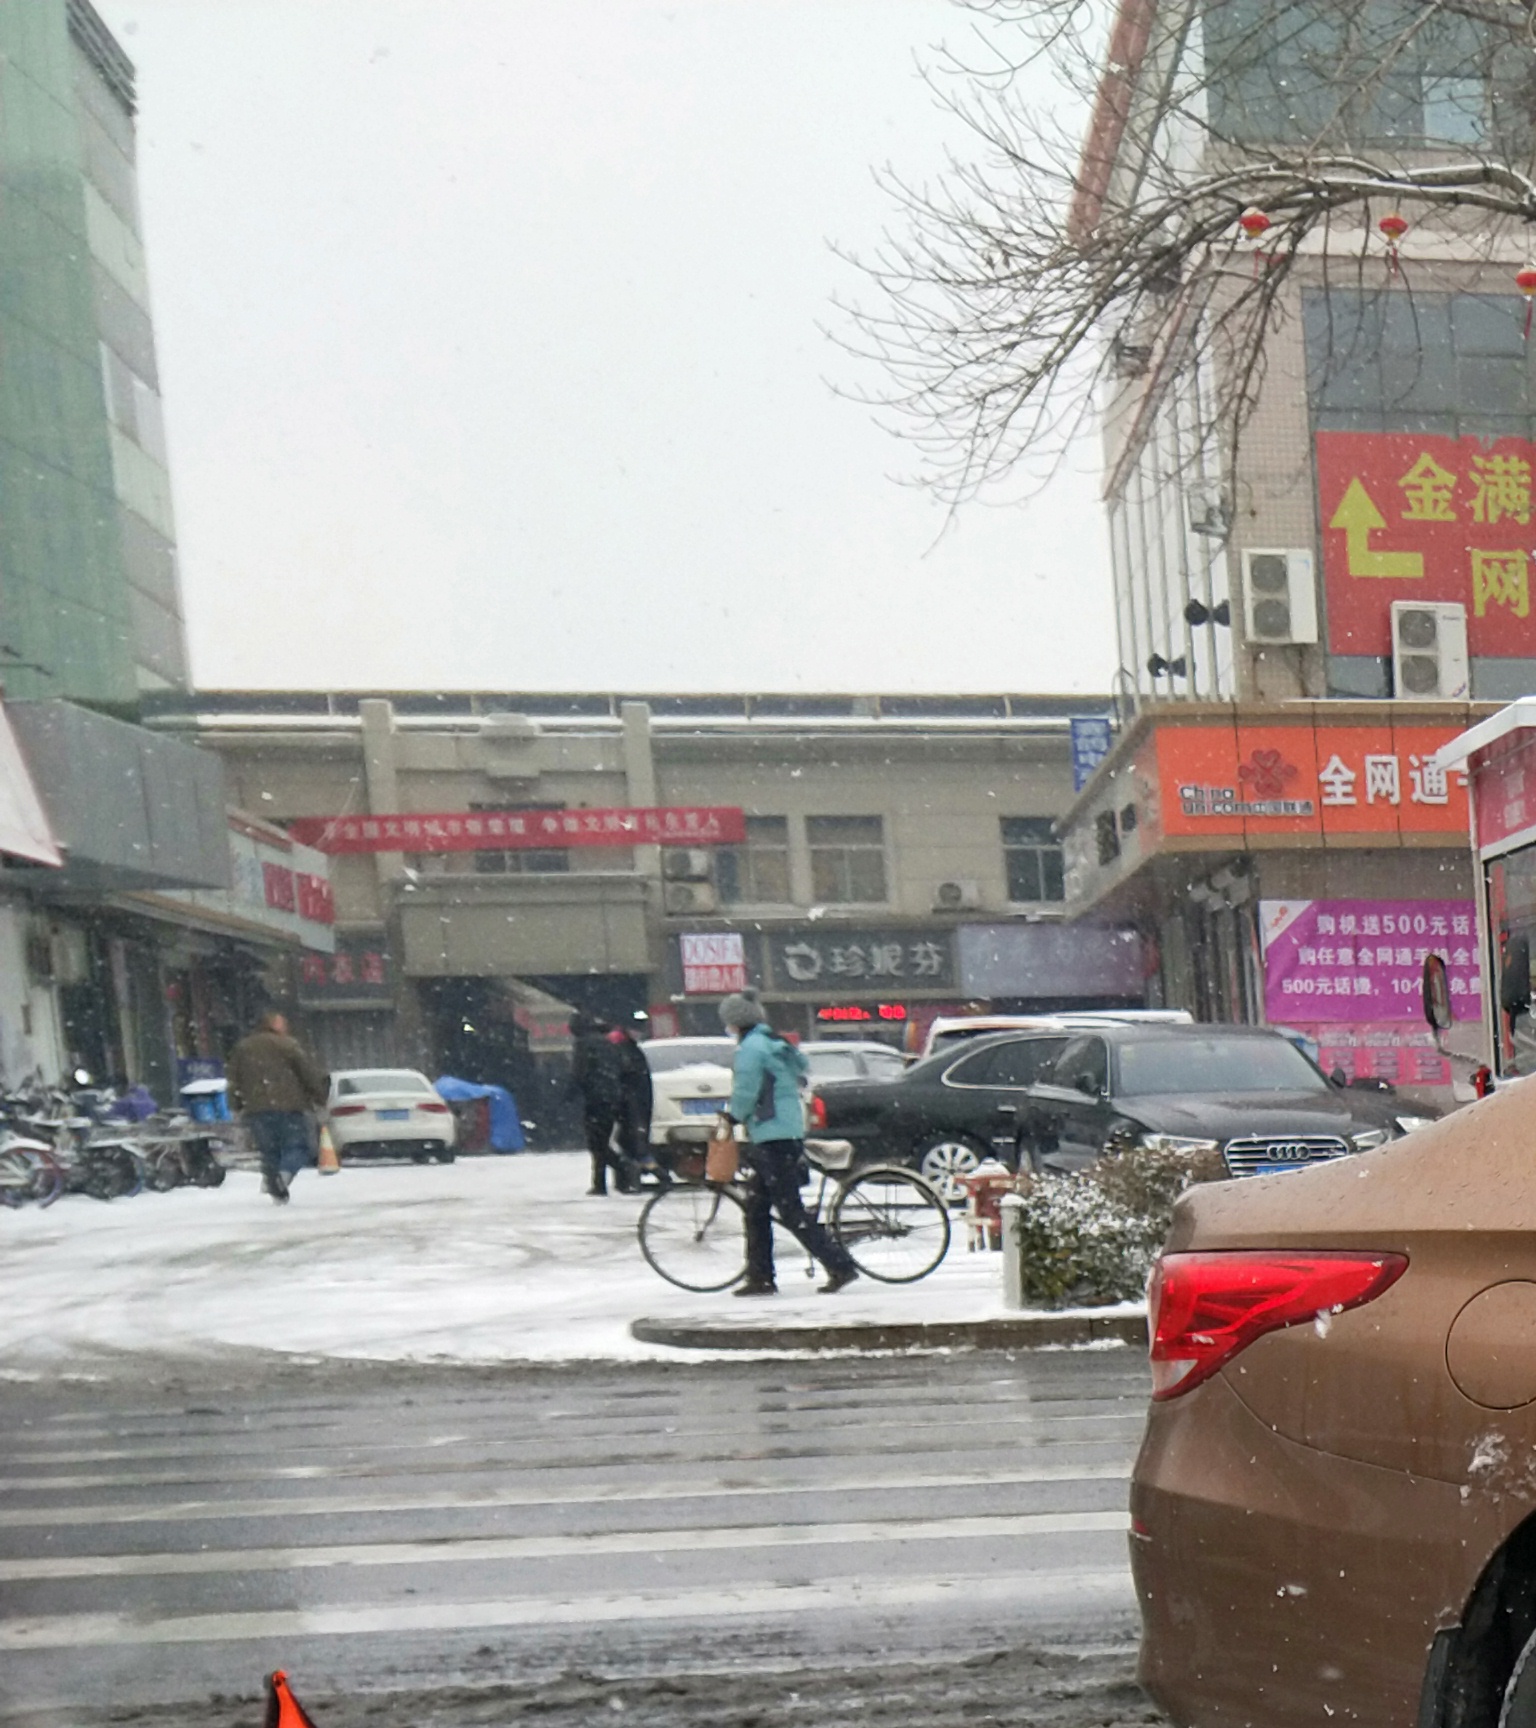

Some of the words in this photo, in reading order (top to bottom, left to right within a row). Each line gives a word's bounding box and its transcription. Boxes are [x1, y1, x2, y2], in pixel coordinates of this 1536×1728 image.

[1318, 753, 1468, 806] 全网通
[1316, 914, 1480, 936] 购机送500元话
